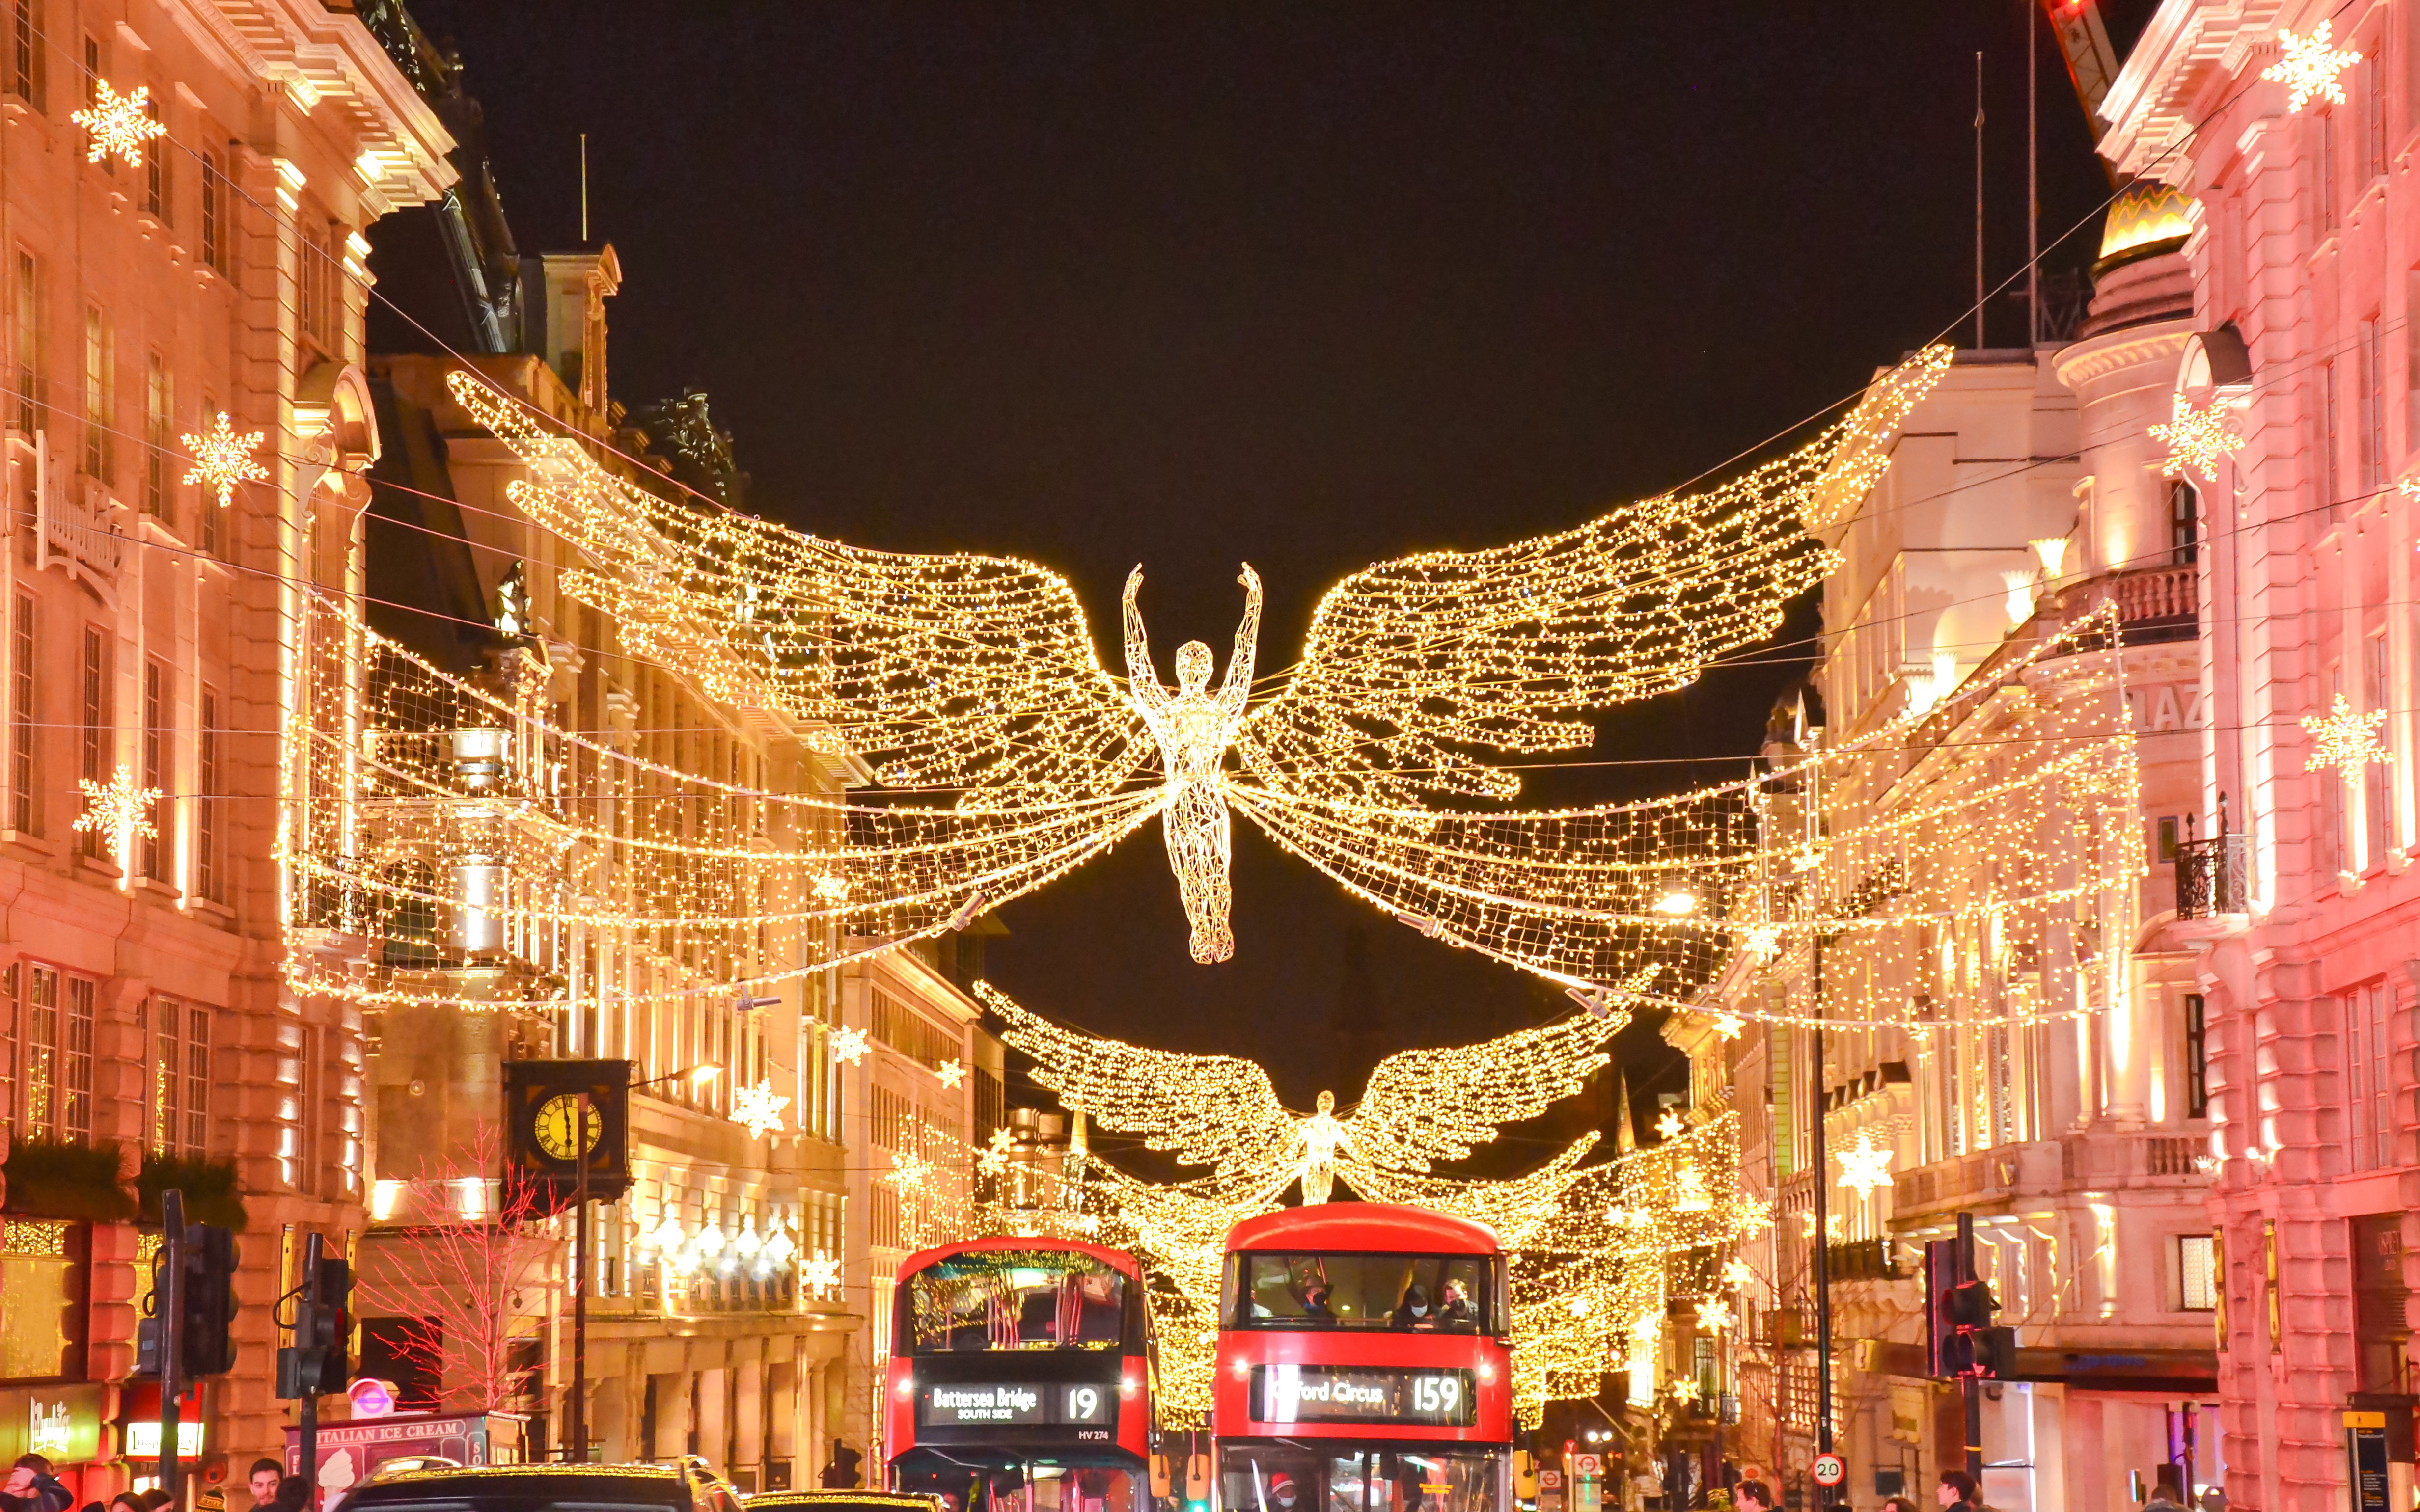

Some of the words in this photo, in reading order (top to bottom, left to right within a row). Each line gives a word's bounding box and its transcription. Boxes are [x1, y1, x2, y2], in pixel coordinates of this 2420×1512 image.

[934, 1388, 995, 1408] Battersea
[997, 1387, 1037, 1412] Bridge
[1273, 1381, 1329, 1401] Oford
[1333, 1382, 1384, 1403] Circus
[1414, 1378, 1459, 1412] 159
[958, 1409, 991, 1419] SOUTH
[992, 1409, 1013, 1419] SIDE
[1069, 1388, 1097, 1419] 19
[316, 1429, 375, 1444] ITALIAN
[380, 1427, 402, 1440] ICE
[407, 1423, 457, 1437] CREAM
[1078, 1431, 1093, 1440] HV
[1094, 1431, 1109, 1440] 274
[1566, 1441, 1575, 1452] Y
[1817, 1463, 1839, 1476] 20
